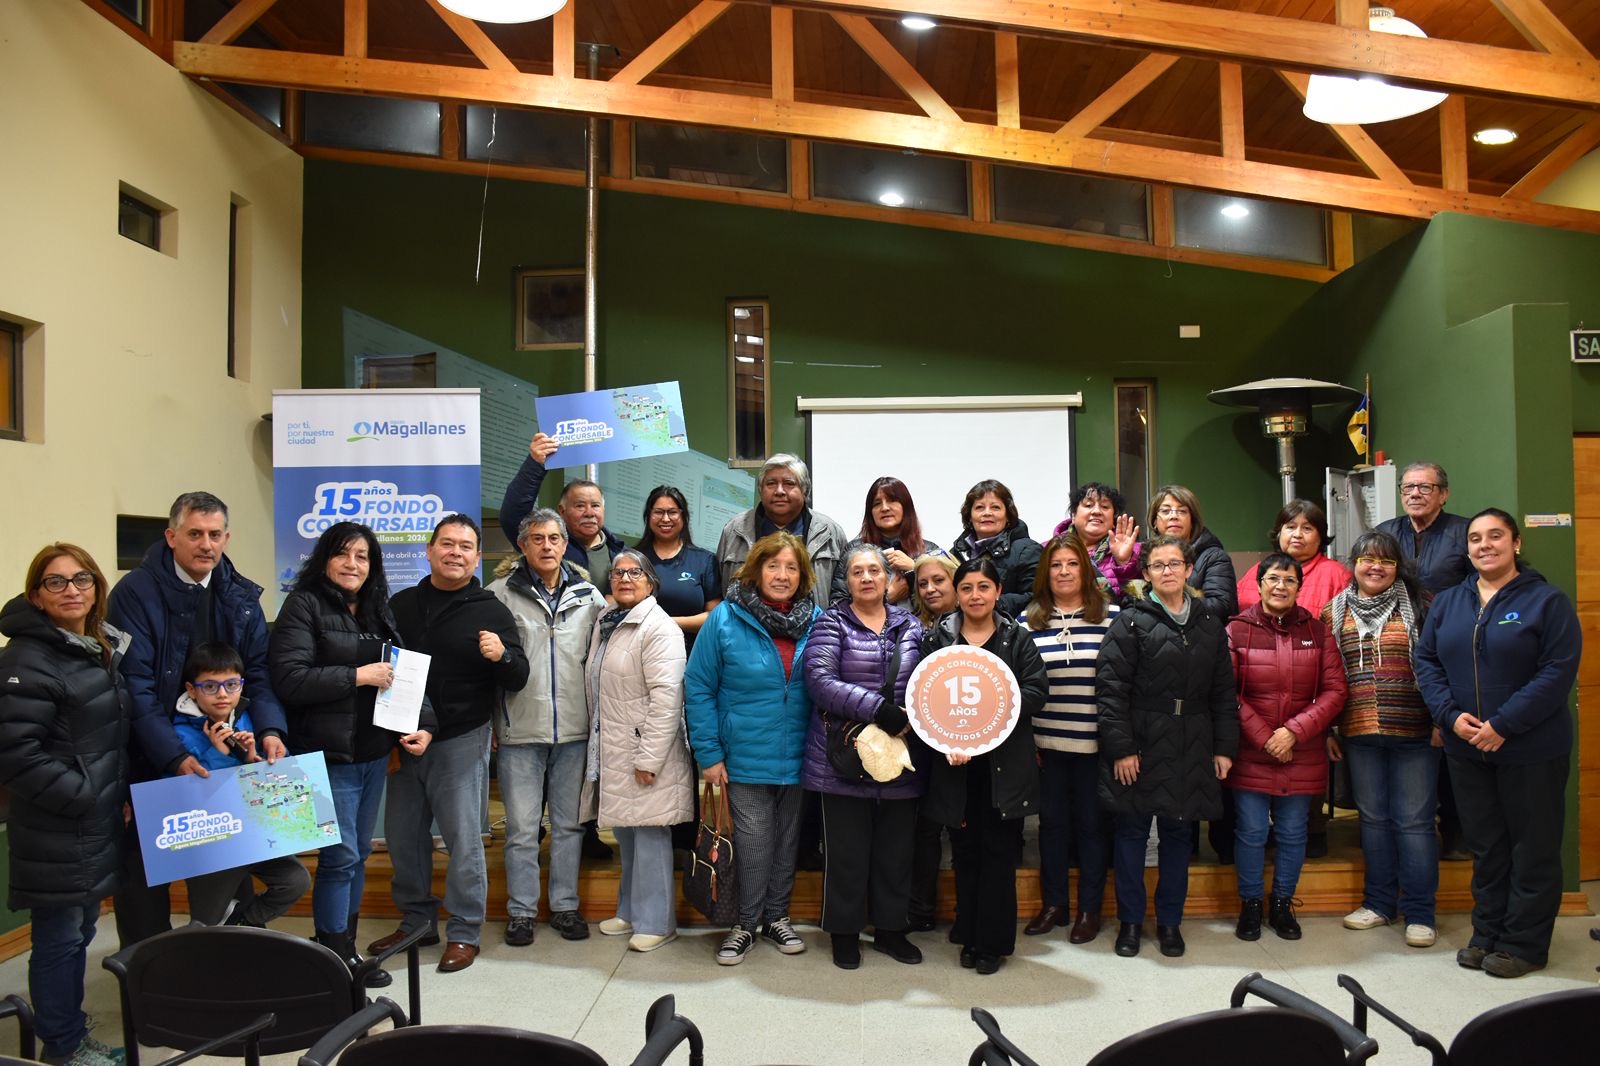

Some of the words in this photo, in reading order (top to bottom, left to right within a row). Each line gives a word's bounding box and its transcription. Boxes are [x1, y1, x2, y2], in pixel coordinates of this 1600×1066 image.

[303, 429, 335, 437] nuestra
[373, 421, 466, 438] Magallanes
[559, 423, 575, 435] 15
[576, 423, 605, 433] FONDO
[288, 437, 316, 445] ciudad
[319, 487, 362, 516] 15
[364, 486, 392, 496] años
[364, 500, 438, 515] FONDO
[303, 516, 436, 533] COURSABL
[407, 534, 427, 542] 2026
[396, 551, 410, 559] abril
[923, 666, 945, 693] FONDO
[947, 660, 1004, 693] CONCURSABLE
[943, 675, 982, 705] 15
[949, 706, 978, 716] AÑOS
[921, 702, 981, 741] COMPROMETIDOS
[982, 702, 1006, 734] CONTIGO
[167, 815, 189, 835] 15
[191, 815, 230, 830] FONDO
[160, 822, 239, 846] CONCURSABLE
